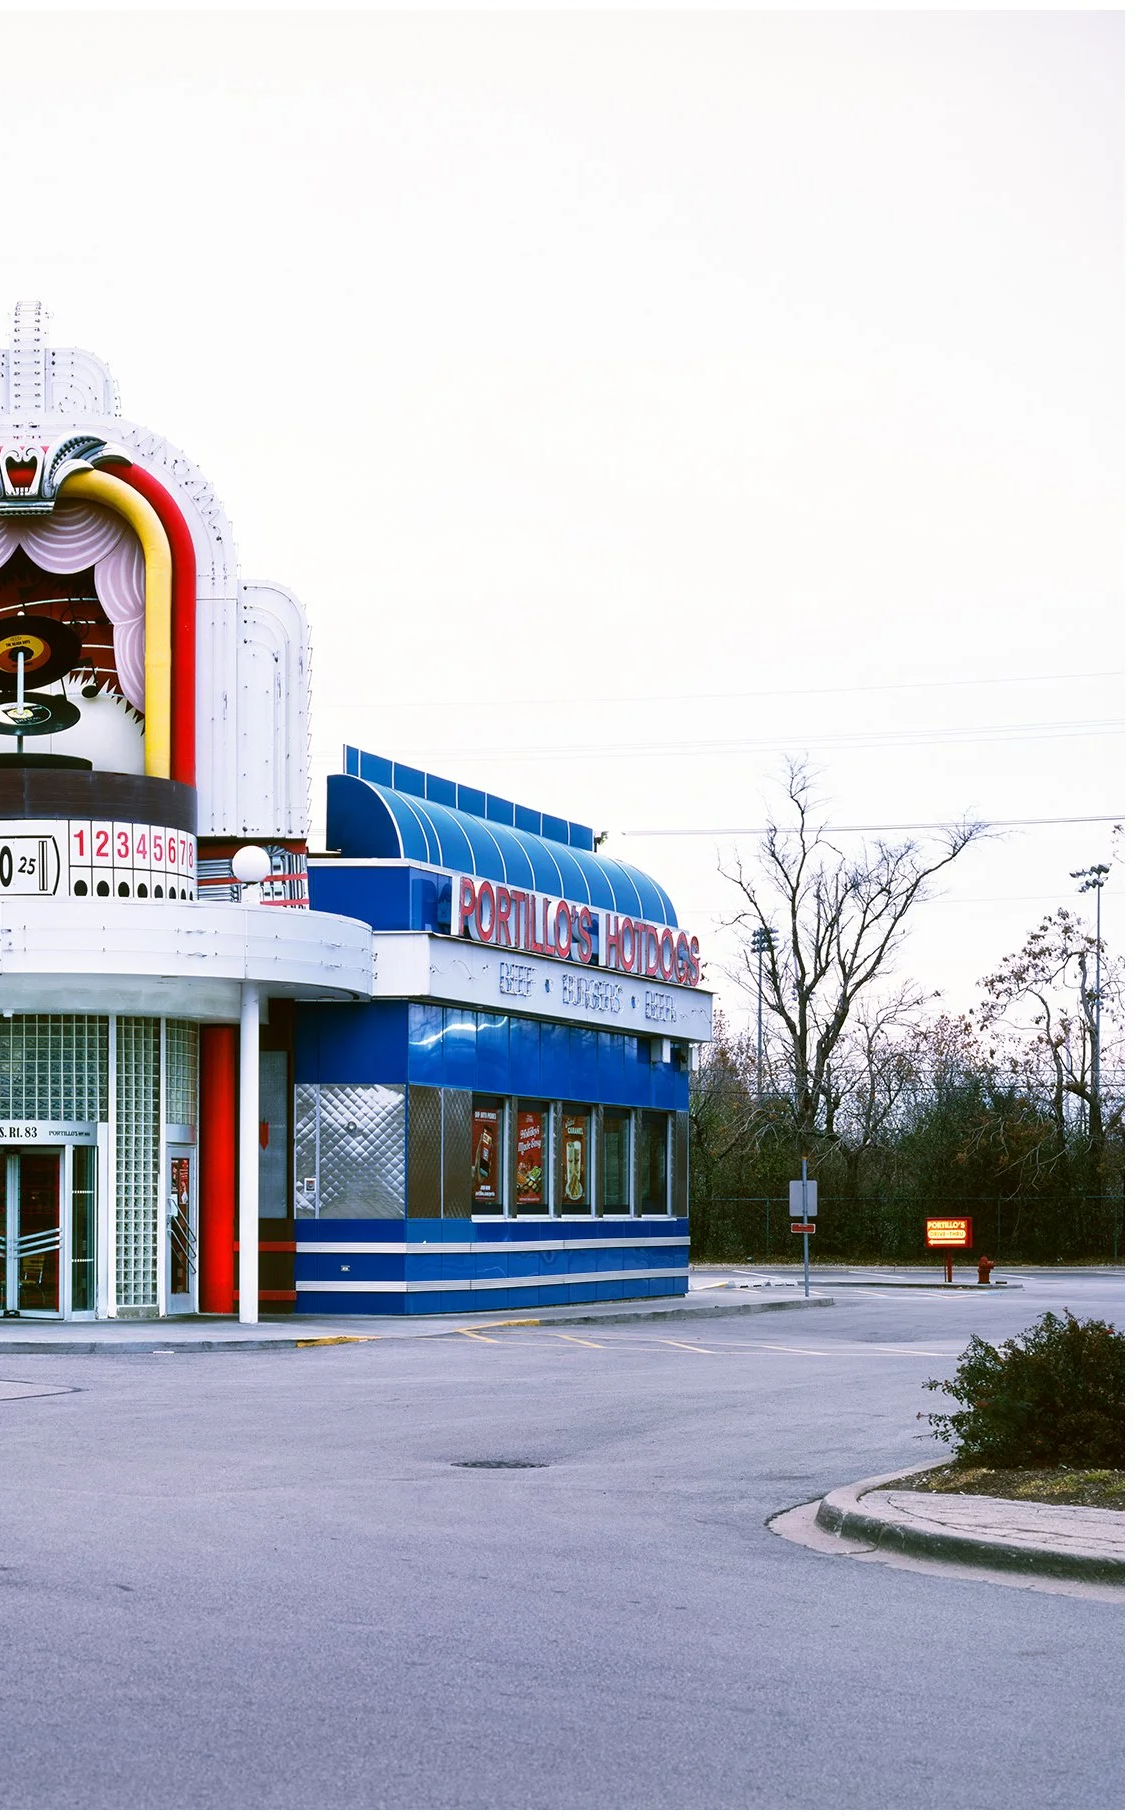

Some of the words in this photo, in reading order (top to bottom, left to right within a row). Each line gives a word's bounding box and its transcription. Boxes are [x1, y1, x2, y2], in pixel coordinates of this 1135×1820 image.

[18, 855, 37, 876] 25
[458, 876, 593, 964] PORTILLO'S
[605, 913, 702, 987] HOTDOGS
[0, 1126, 7, 1138] S.
[9, 1126, 23, 1138] Rt.
[24, 1126, 38, 1138] 83
[927, 1221, 966, 1229] PORTILLO'S
